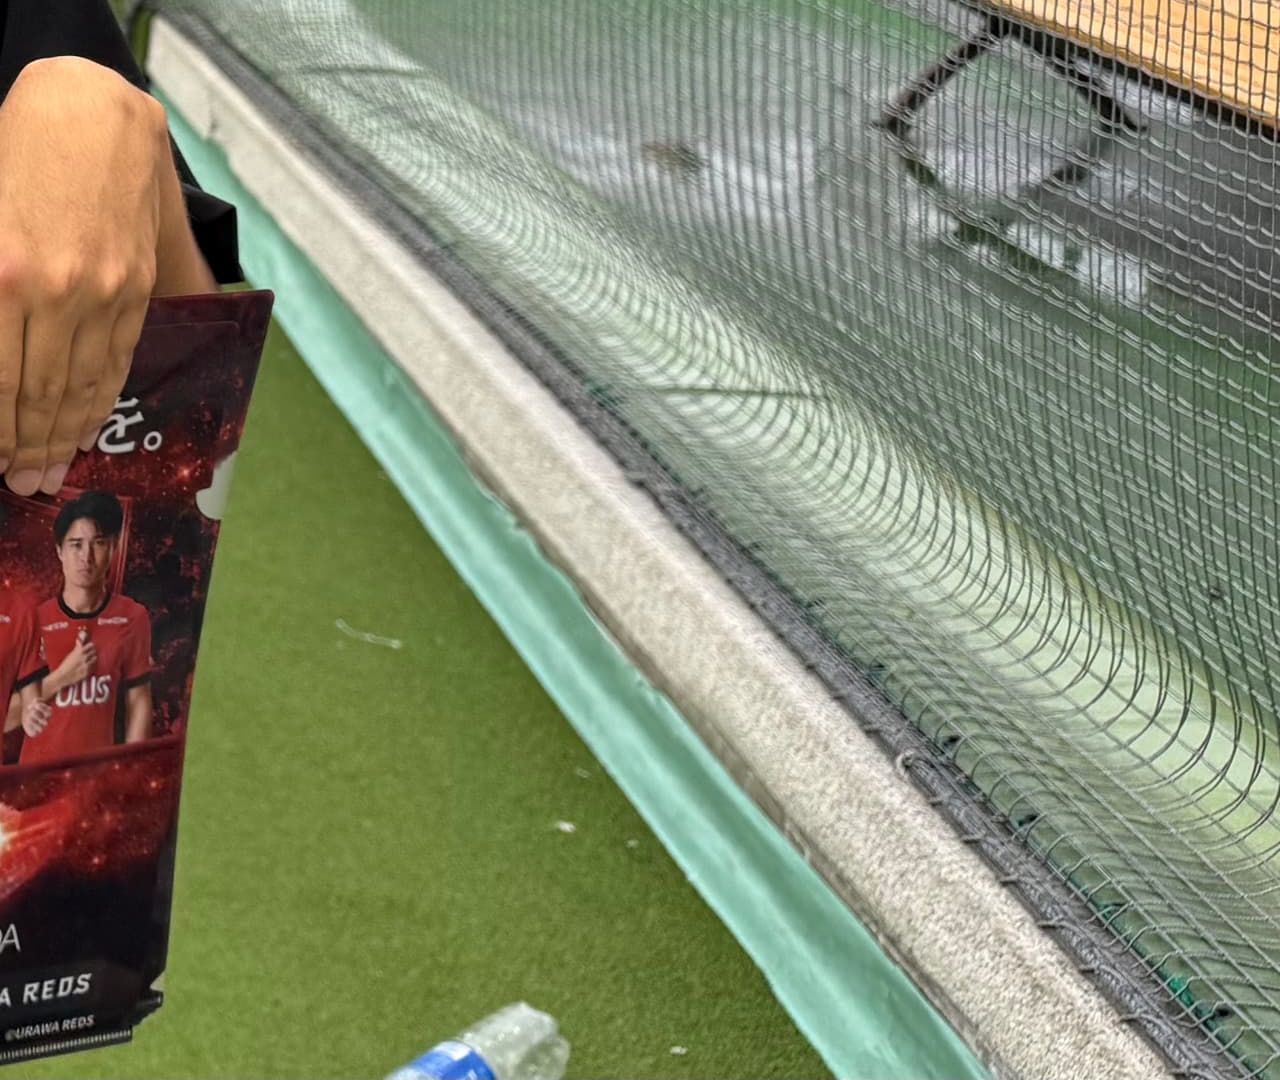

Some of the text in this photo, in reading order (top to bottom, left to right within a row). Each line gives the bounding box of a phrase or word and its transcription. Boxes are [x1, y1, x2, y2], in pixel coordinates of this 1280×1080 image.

[55, 674, 112, 708] OLUS
[22, 973, 94, 1007] REDS
[61, 1014, 96, 1031] REDS
